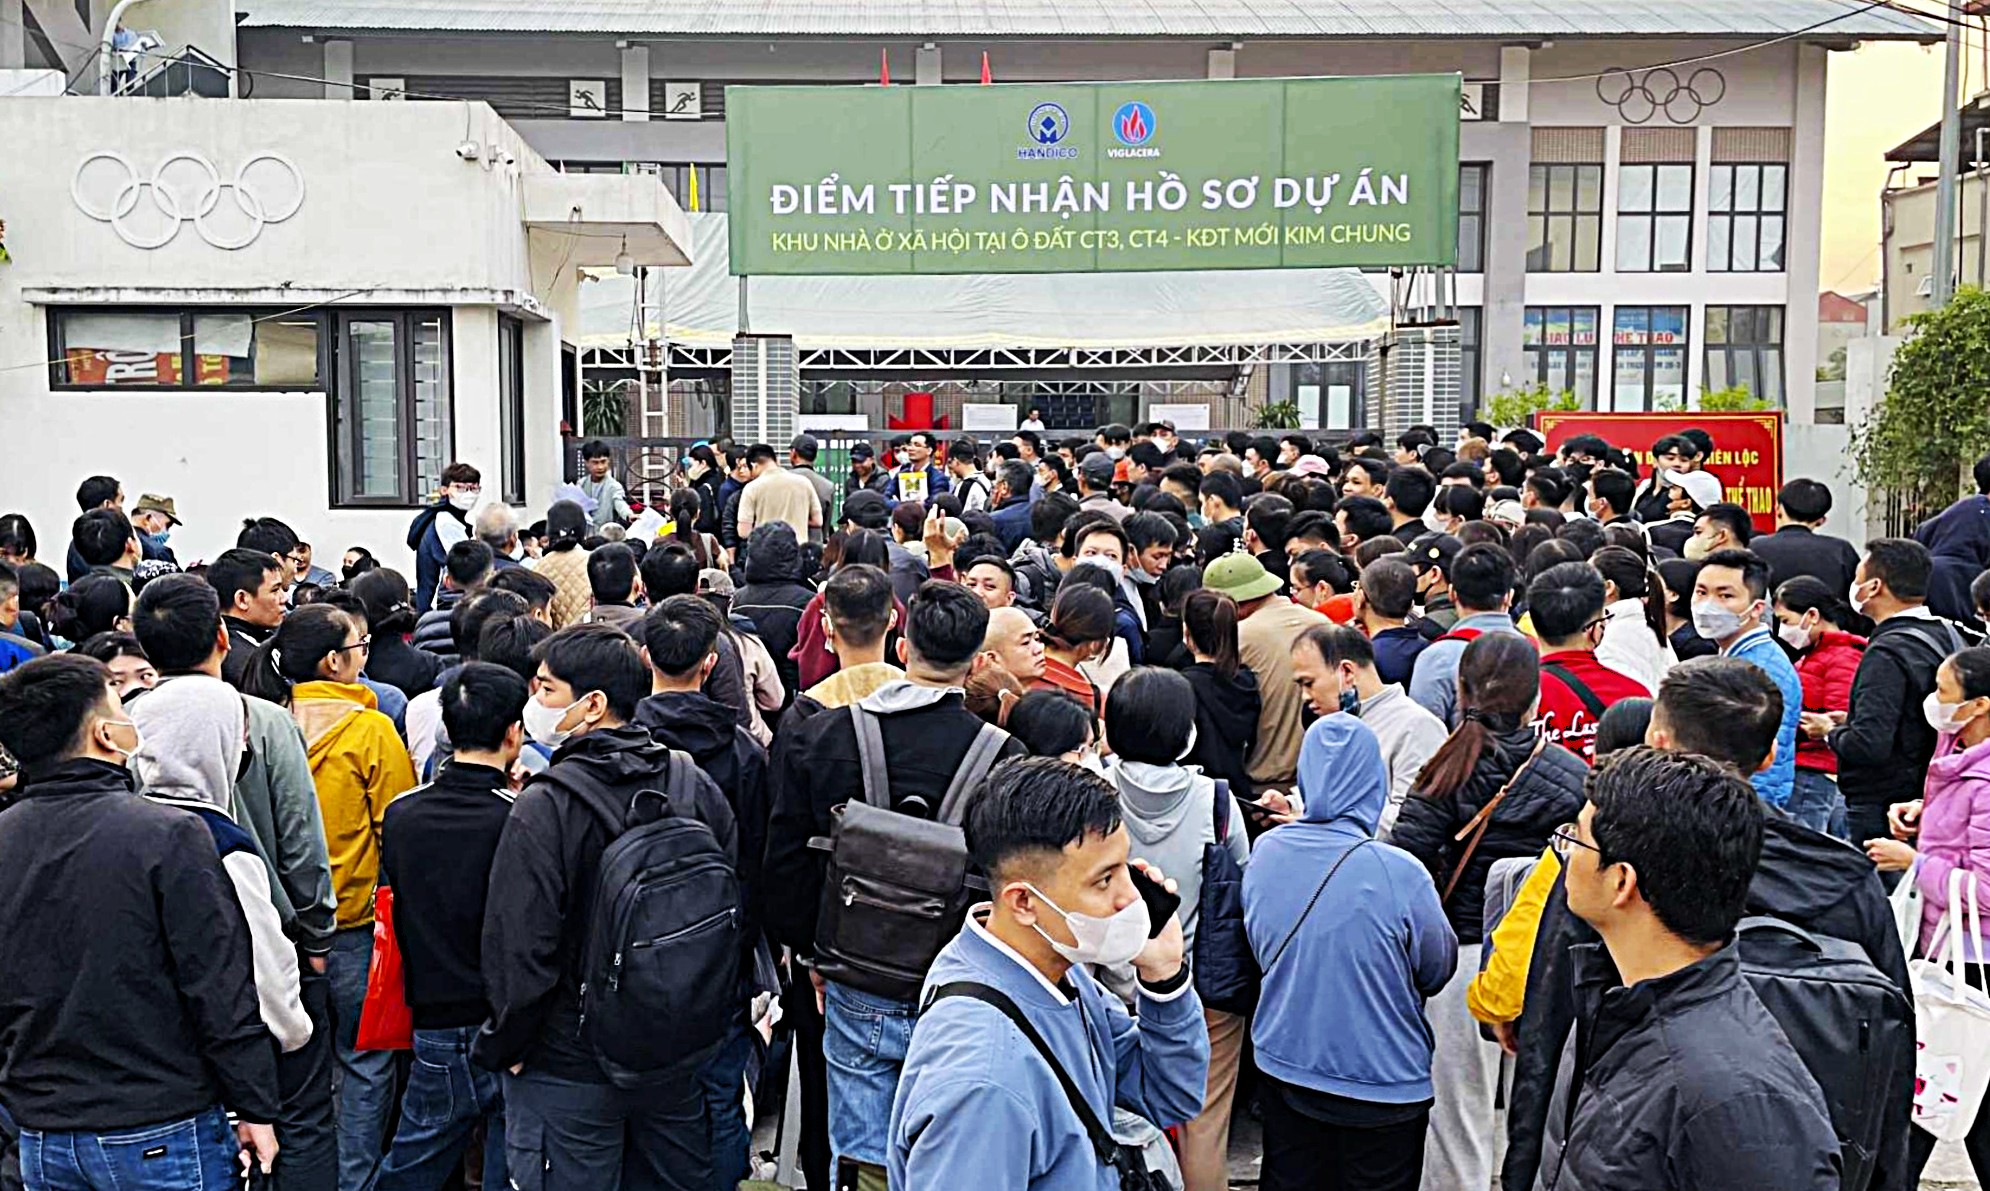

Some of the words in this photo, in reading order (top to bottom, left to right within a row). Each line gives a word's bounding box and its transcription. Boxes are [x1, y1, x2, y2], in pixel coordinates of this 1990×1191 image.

[1018, 147, 1078, 158] HANDICO
[1107, 148, 1160, 158] VIGLACERA
[770, 172, 875, 215] ĐIỂM
[889, 174, 976, 214] TIẾP
[991, 175, 1109, 219] NHẬN
[1126, 170, 1188, 211] HỒ
[1202, 175, 1259, 210] SƠ
[1274, 173, 1340, 214] DỰ
[1349, 167, 1408, 205] ÁN
[772, 232, 818, 251] KHU
[824, 227, 869, 251] NHÀ
[876, 228, 894, 251] Ở
[898, 228, 927, 250] XÃ
[935, 226, 970, 254] HỘI
[975, 231, 1006, 254] TẠI
[1011, 227, 1029, 250] Ô
[1033, 225, 1077, 249] ĐẤT
[1080, 230, 1124, 250] CT3,
[1128, 230, 1169, 248] CT4
[1187, 228, 1231, 247] KĐT
[1235, 223, 1279, 246] MỚI
[1285, 226, 1325, 245] KIM
[1331, 223, 1411, 244] CHUNG
[1637, 332, 1674, 343] TAO
[1704, 448, 1732, 465] IÊN
[1735, 448, 1759, 468] LỘC
[1746, 486, 1773, 514] THAO
[1528, 711, 1560, 742] The
[1563, 710, 1599, 738] Las
